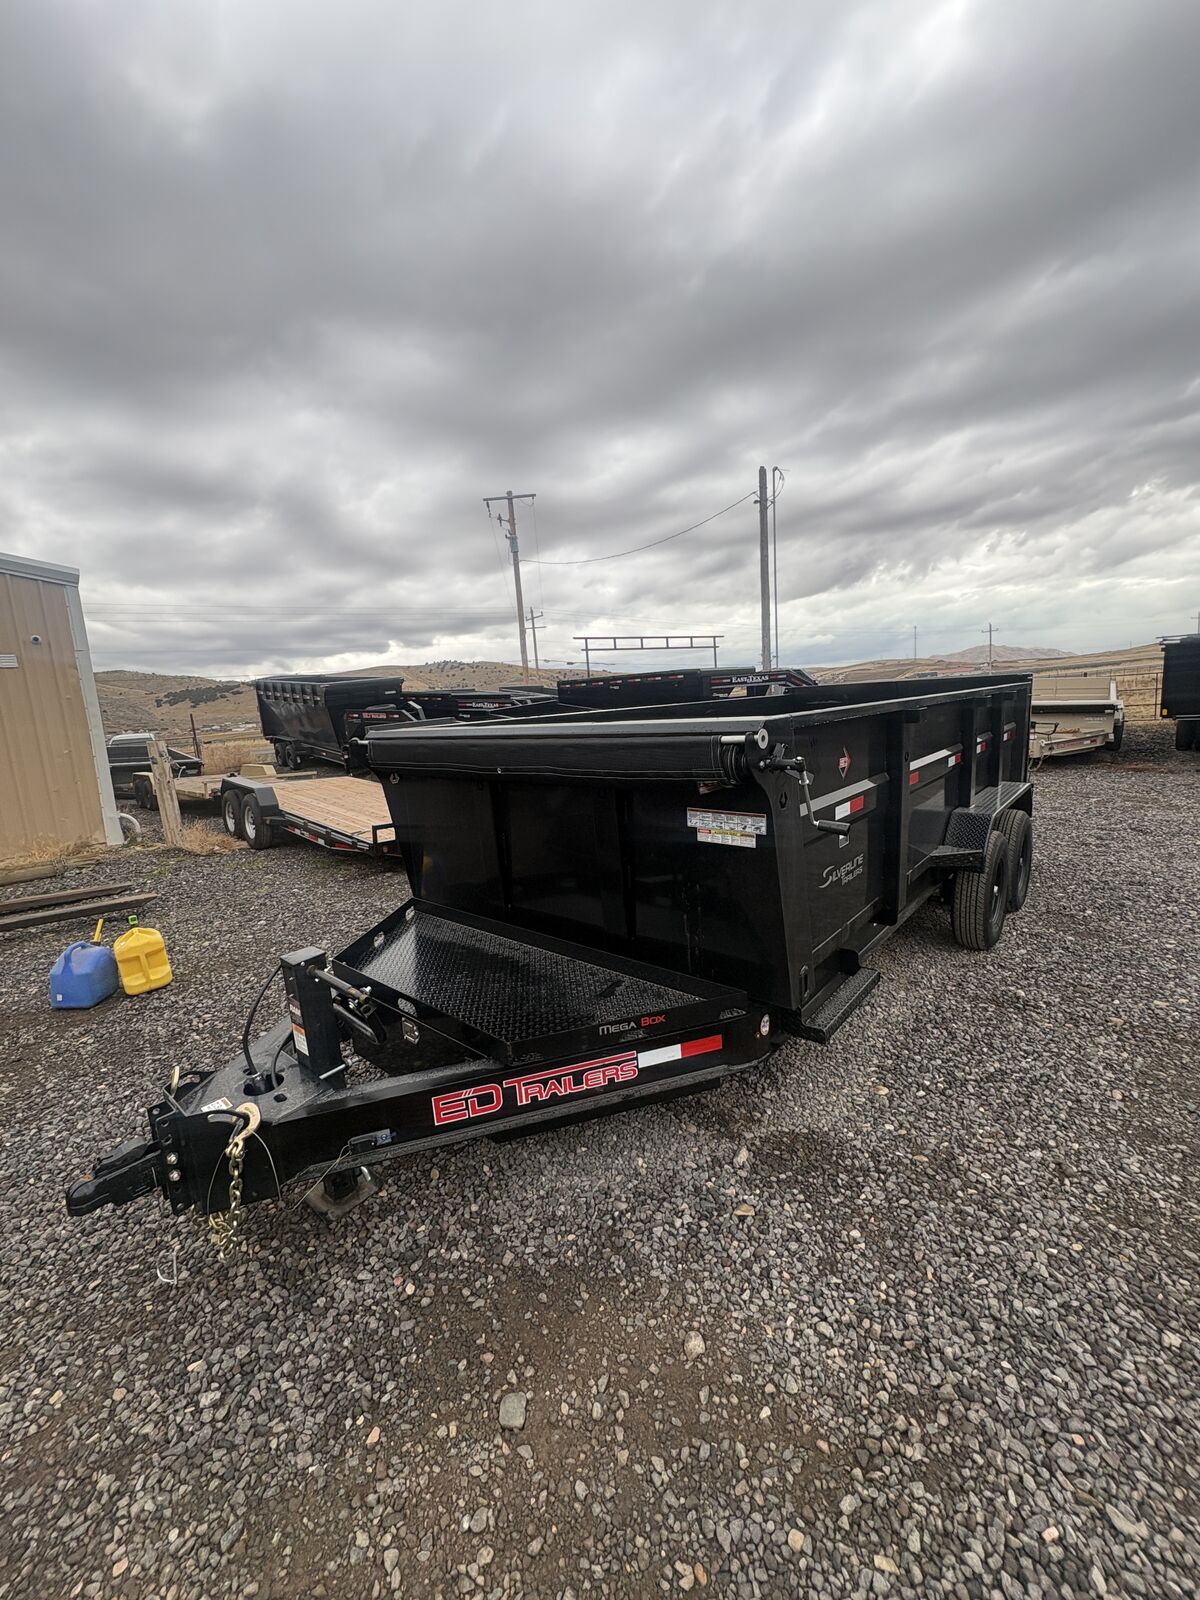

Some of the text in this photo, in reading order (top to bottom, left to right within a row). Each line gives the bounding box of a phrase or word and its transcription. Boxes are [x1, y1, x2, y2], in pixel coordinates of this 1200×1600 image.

[747, 675, 769, 683] TEXAS
[818, 853, 864, 888] SILVERLINE
[599, 1014, 668, 1036] MEGA BOX
[503, 1050, 638, 1106] TRAILERS
